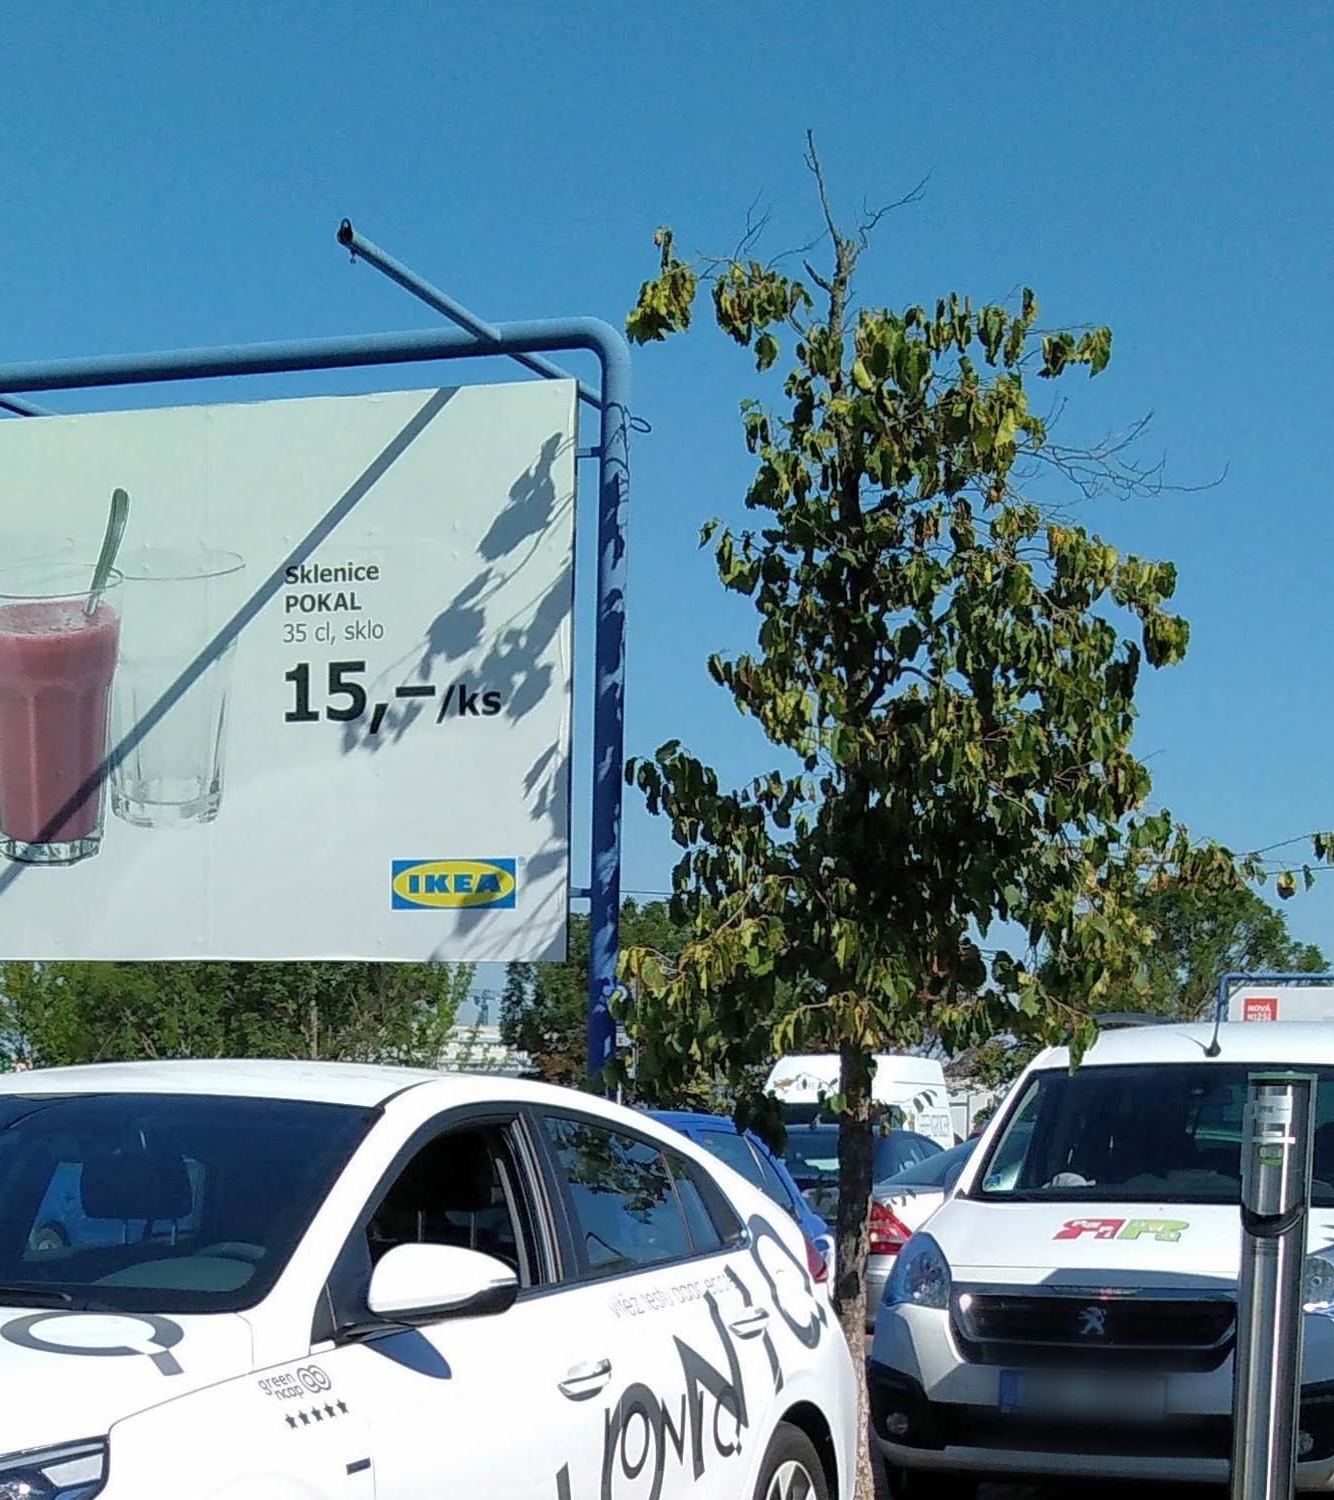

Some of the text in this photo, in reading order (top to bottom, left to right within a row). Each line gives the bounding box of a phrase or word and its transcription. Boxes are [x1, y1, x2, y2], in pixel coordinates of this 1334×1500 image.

[284, 562, 380, 584] Sklenice
[284, 592, 363, 613] POKAL
[282, 620, 385, 645] 35 cl, sklo
[408, 873, 502, 895] IKEA
[258, 1373, 296, 1396] green
[274, 1385, 305, 1401] ncap
